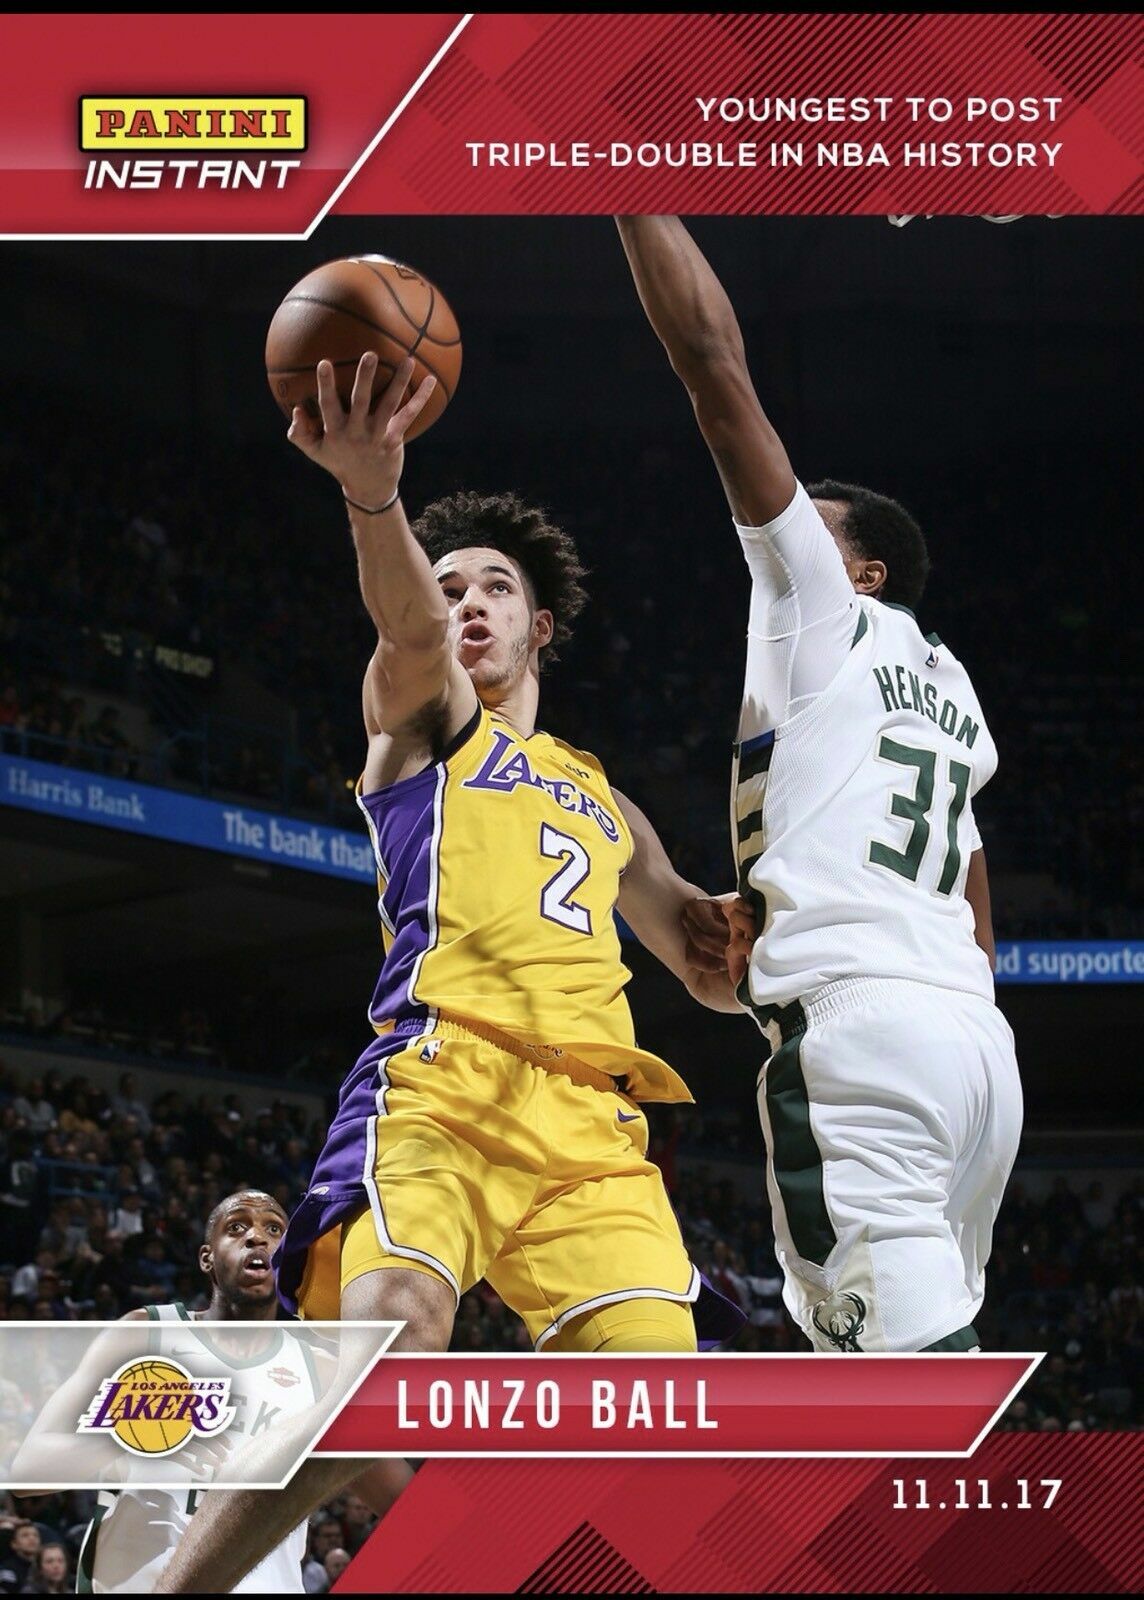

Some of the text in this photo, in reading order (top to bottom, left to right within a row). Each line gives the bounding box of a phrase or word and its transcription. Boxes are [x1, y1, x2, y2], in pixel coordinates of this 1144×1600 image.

[873, 665, 980, 750] HENSON
[8, 768, 145, 821] Harris Bank
[864, 733, 972, 900] 31
[223, 812, 264, 848] The
[269, 821, 324, 863] bank
[540, 820, 593, 936] 2
